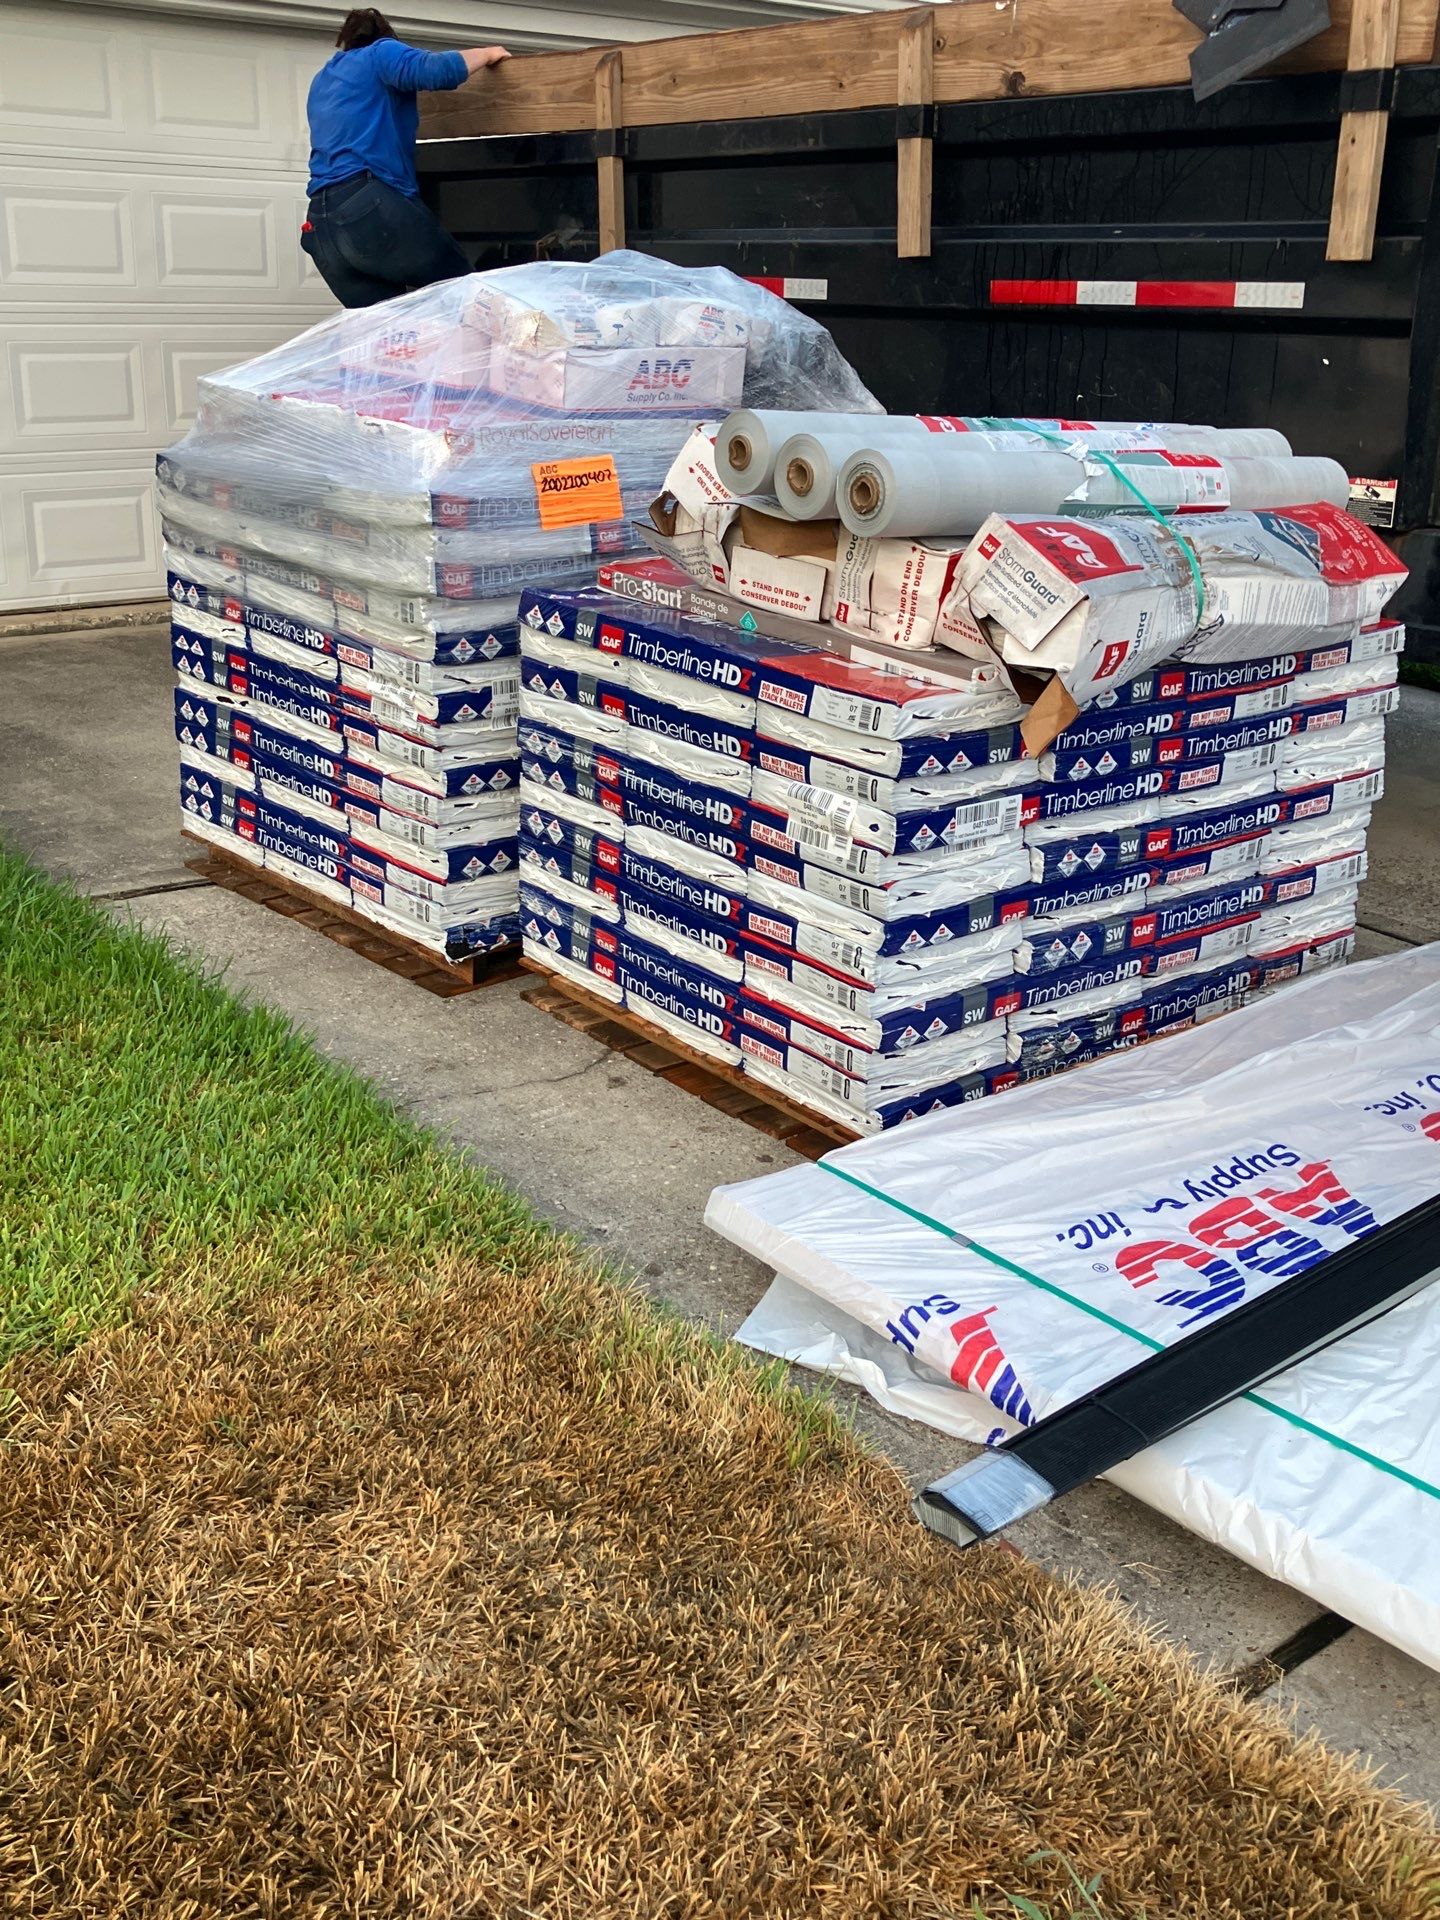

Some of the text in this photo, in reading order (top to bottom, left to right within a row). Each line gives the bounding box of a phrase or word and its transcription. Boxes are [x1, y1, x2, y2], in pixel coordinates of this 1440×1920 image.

[702, 306, 724, 316] ABC
[625, 358, 695, 391] ABC
[627, 392, 656, 403] Supply
[658, 391, 672, 401] Co.
[696, 460, 715, 482] DEBOUT
[696, 476, 712, 496] ON END
[1361, 478, 1389, 488] DANGER
[441, 502, 467, 515] GAF
[982, 540, 997, 554] GAF
[1035, 525, 1108, 569] GAF
[445, 573, 470, 586] GAF
[600, 570, 612, 581] GAF
[998, 546, 1061, 606] StormGuard
[612, 571, 684, 610] Pro-Start
[752, 581, 800, 599] STAND ON END
[897, 559, 913, 625] STAND ON END
[903, 550, 928, 642] CONSERVER DEBOUT
[690, 594, 729, 614] Bande de
[741, 589, 807, 613] CONSERVER DEBOUT
[225, 607, 241, 619] GAF
[690, 604, 717, 620] départ
[576, 622, 594, 639] SW
[953, 618, 978, 634] STAND
[601, 634, 622, 651] GAF
[212, 651, 225, 663] SW
[1101, 646, 1120, 677] GAF
[214, 672, 226, 686] SW
[232, 683, 246, 695] GAF
[762, 683, 806, 703] DO NOT TRIPLE
[1132, 681, 1152, 698] SW
[1161, 683, 1183, 697] GAF
[578, 690, 595, 706] SW
[761, 691, 804, 712] STACK PALLETS
[603, 705, 624, 718] GAF
[849, 704, 858, 712] 07
[217, 717, 230, 731] SW
[236, 729, 250, 741] GAF
[216, 744, 229, 758] SW
[988, 748, 1011, 764] SW
[1131, 749, 1150, 764] SW
[1159, 749, 1181, 762] GAF
[234, 757, 249, 769] GAF
[573, 751, 591, 768] SW
[761, 754, 804, 774] DO NOT TRIPLE
[598, 765, 617, 781] GAF
[762, 762, 804, 781] STACK PALLETS
[846, 775, 855, 783] 07
[1182, 766, 1218, 781] DO NOT TRIPLE
[1180, 774, 1217, 788] STACK PALLETS
[577, 783, 594, 800] SW
[222, 794, 235, 808] SW
[602, 799, 621, 815] GAF
[220, 813, 234, 827] SW
[240, 806, 256, 818] GAF
[239, 825, 254, 838] GAF
[753, 822, 795, 845] DO NOT TRIPLE
[575, 833, 592, 849] SW
[752, 831, 794, 852] STACK PALLETS
[1120, 839, 1139, 854] SW
[1148, 839, 1169, 852] GAF
[599, 850, 618, 866] GAF
[756, 857, 798, 881] DO NOT TRIPLE
[572, 871, 589, 886] SW
[750, 914, 791, 935] DO NOT TRIPLE
[970, 915, 992, 933] SW
[1002, 910, 1026, 925] GAF
[573, 921, 589, 937] SW
[750, 922, 791, 943] STACK PALLETS
[1106, 925, 1125, 942] SW
[1133, 923, 1154, 938] GAF
[597, 937, 615, 952] GAF
[571, 945, 588, 962] SW
[595, 962, 613, 979] GAF
[746, 953, 787, 975] DO NOT TRIPLE
[964, 1007, 986, 1025] SW
[994, 1002, 1018, 1017] GAF
[1095, 1023, 1114, 1040] SW
[1122, 1018, 1143, 1032] GAF
[742, 1035, 783, 1061] DO NOT TRIPLE
[742, 1043, 782, 1067] STACK PALLETS
[964, 1086, 984, 1101] SW
[1185, 1142, 1301, 1204] Supply
[1113, 1157, 1382, 1331] ABC
